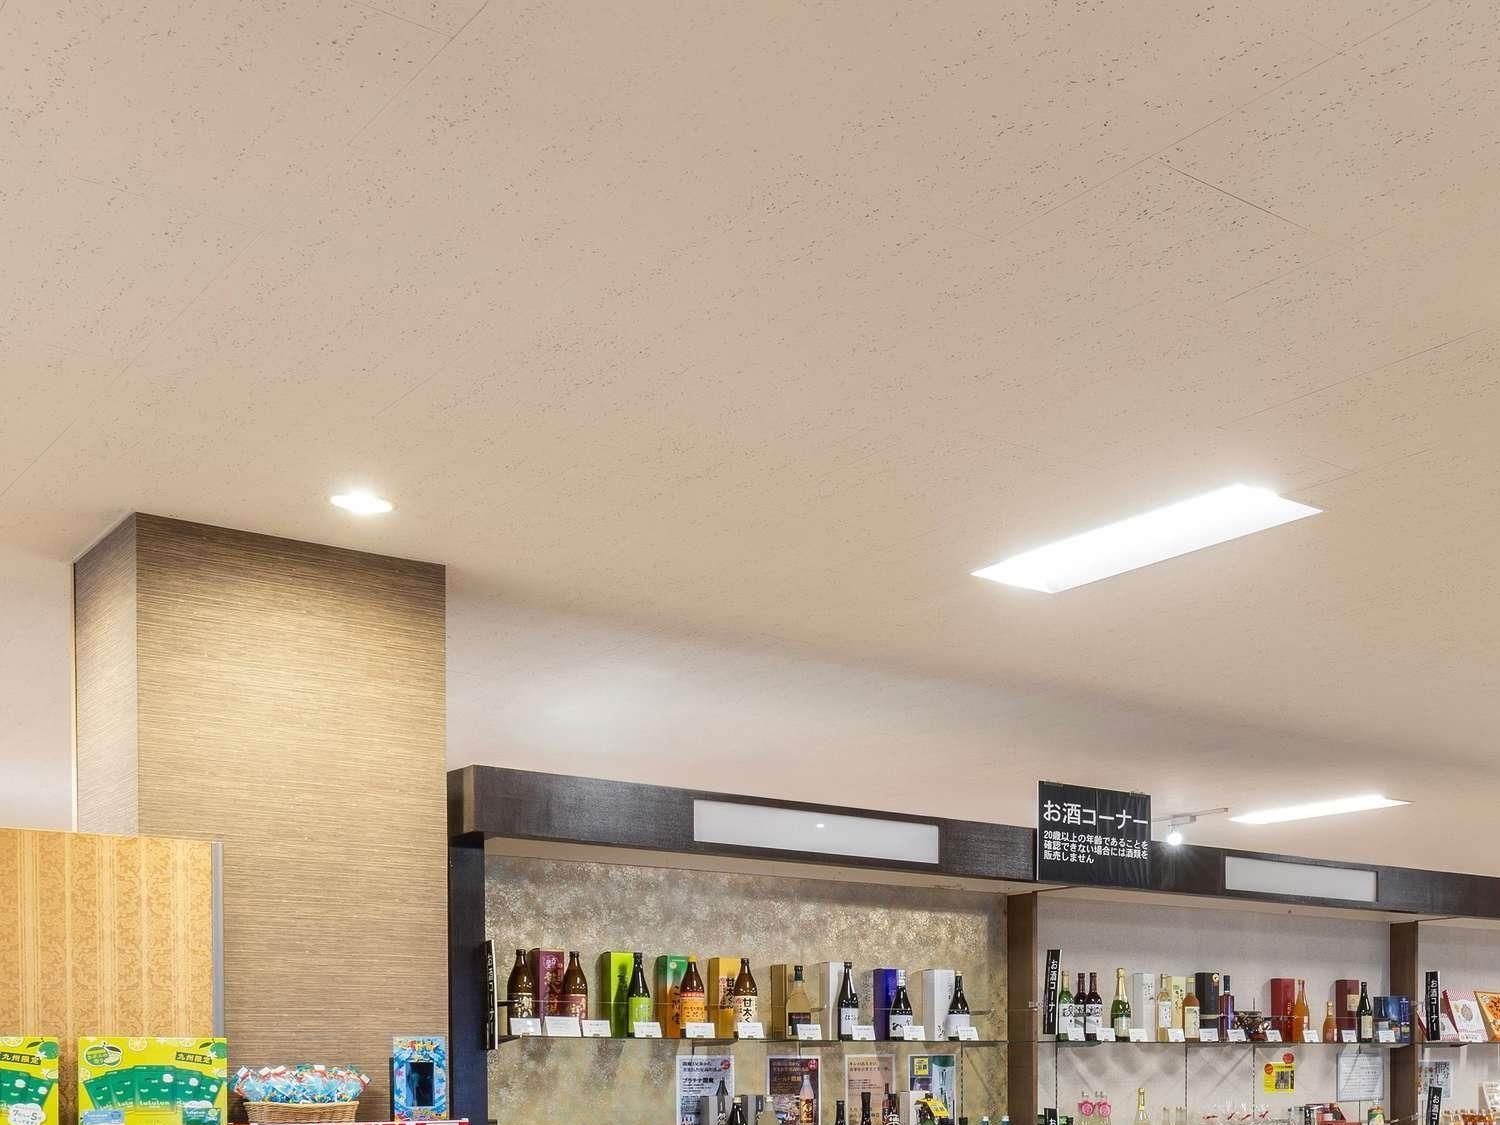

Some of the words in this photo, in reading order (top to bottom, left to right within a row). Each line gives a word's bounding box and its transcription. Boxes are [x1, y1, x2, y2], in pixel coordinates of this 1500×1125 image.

[1043, 800, 1148, 829] お酒コーナー
[1044, 830, 1148, 849] 20歳以上の年齢であることを
[1044, 840, 1148, 859] 確認できない場合には酒類を
[1044, 850, 1094, 863] 販売しません
[1050, 960, 1058, 1023] お酒コーナー
[1430, 980, 1438, 1031] お酒コーナー
[1, 1053, 41, 1065] 九州限定
[176, 1052, 213, 1065] 九州限定
